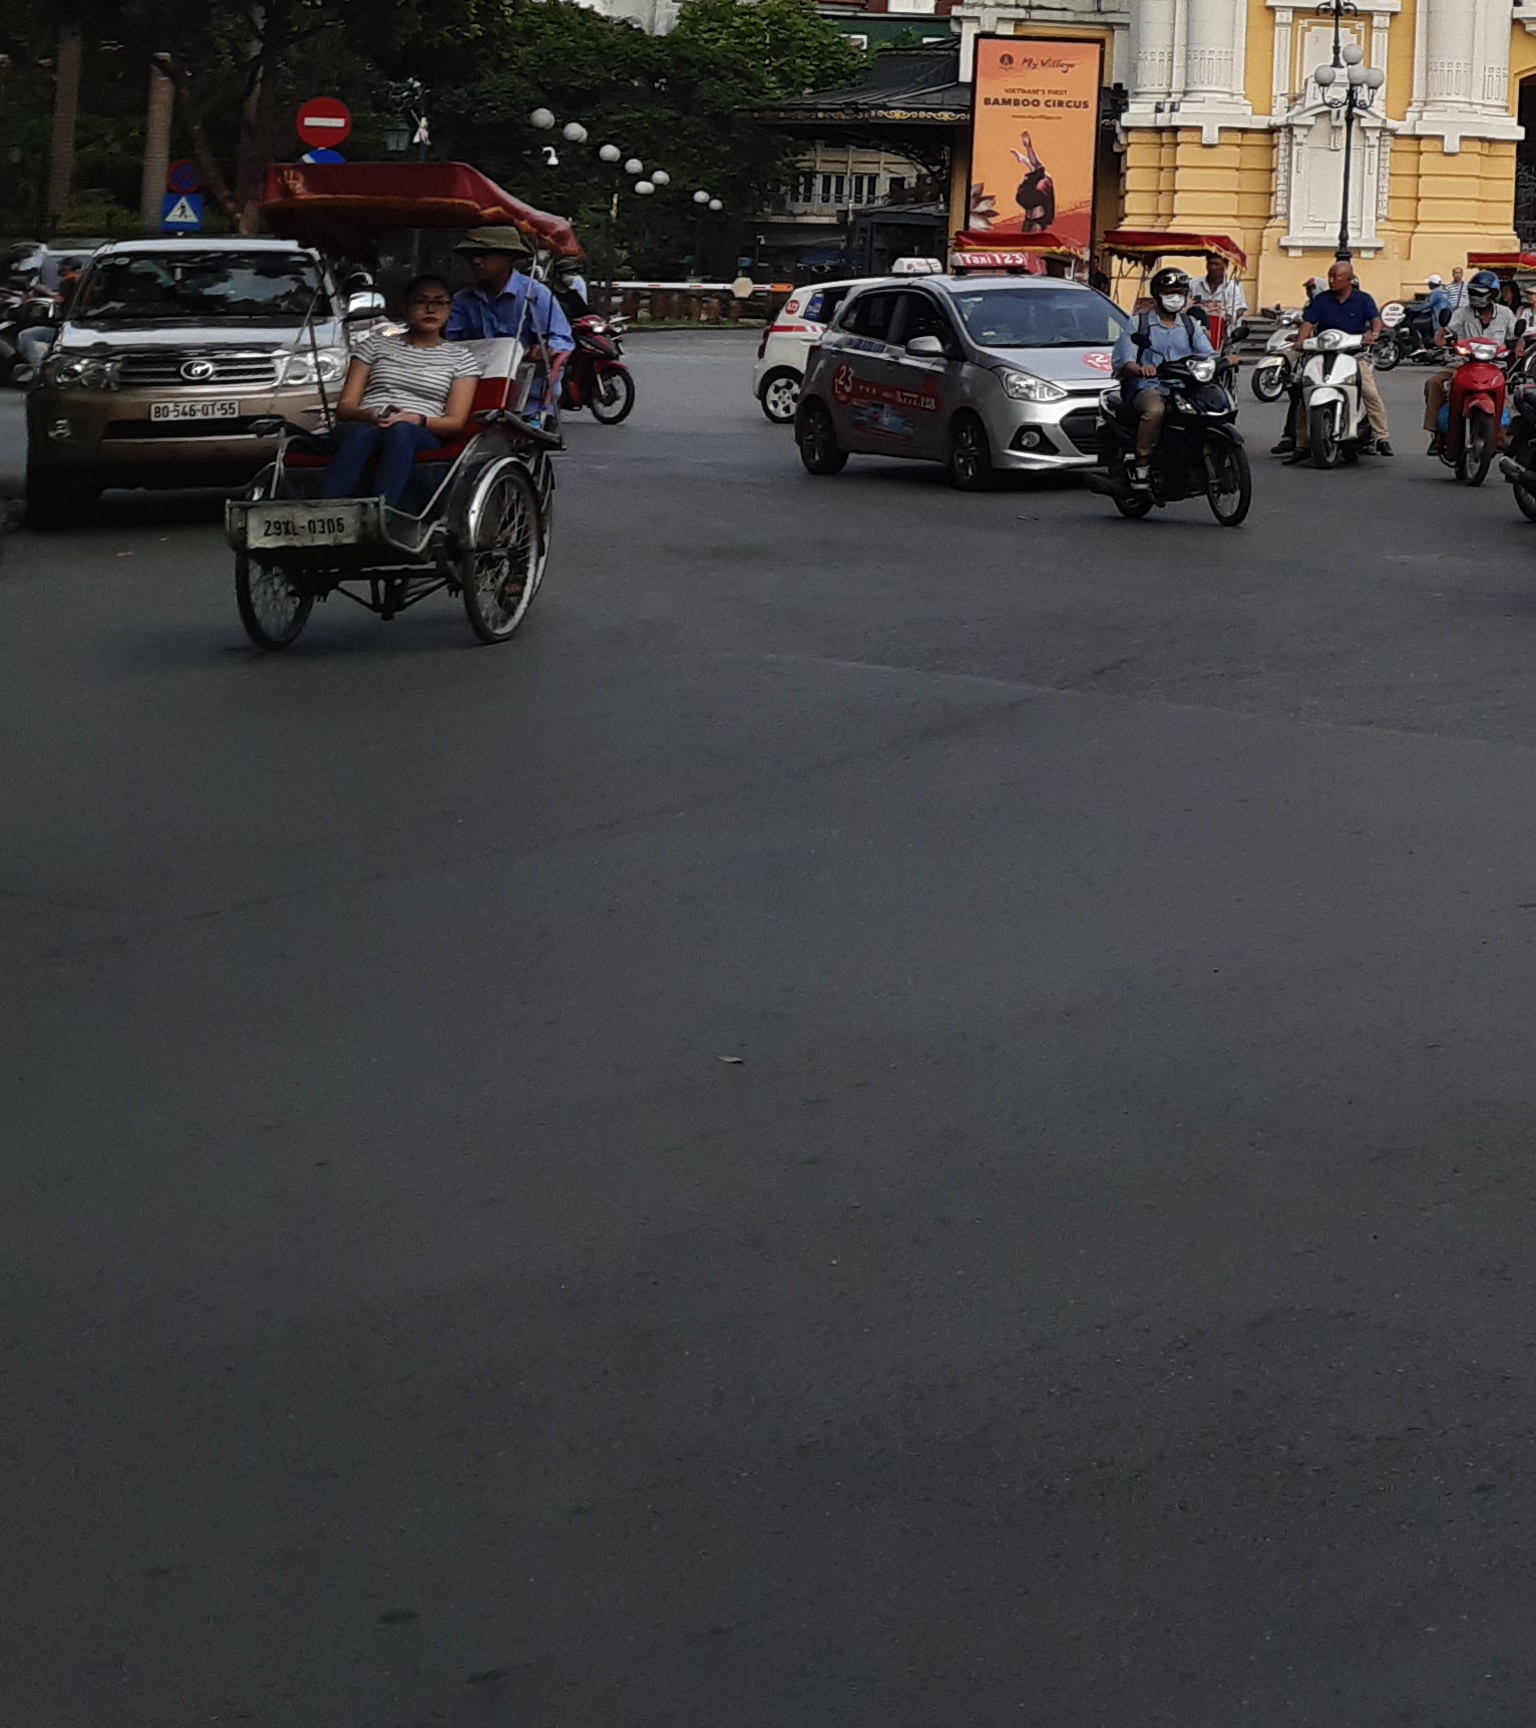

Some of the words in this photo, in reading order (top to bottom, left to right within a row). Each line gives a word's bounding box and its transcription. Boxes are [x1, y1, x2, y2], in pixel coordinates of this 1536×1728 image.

[983, 97, 1041, 108] BAMBOO
[1044, 99, 1089, 109] CIRCUS
[962, 254, 992, 264] Taxi
[992, 253, 1024, 265] 123
